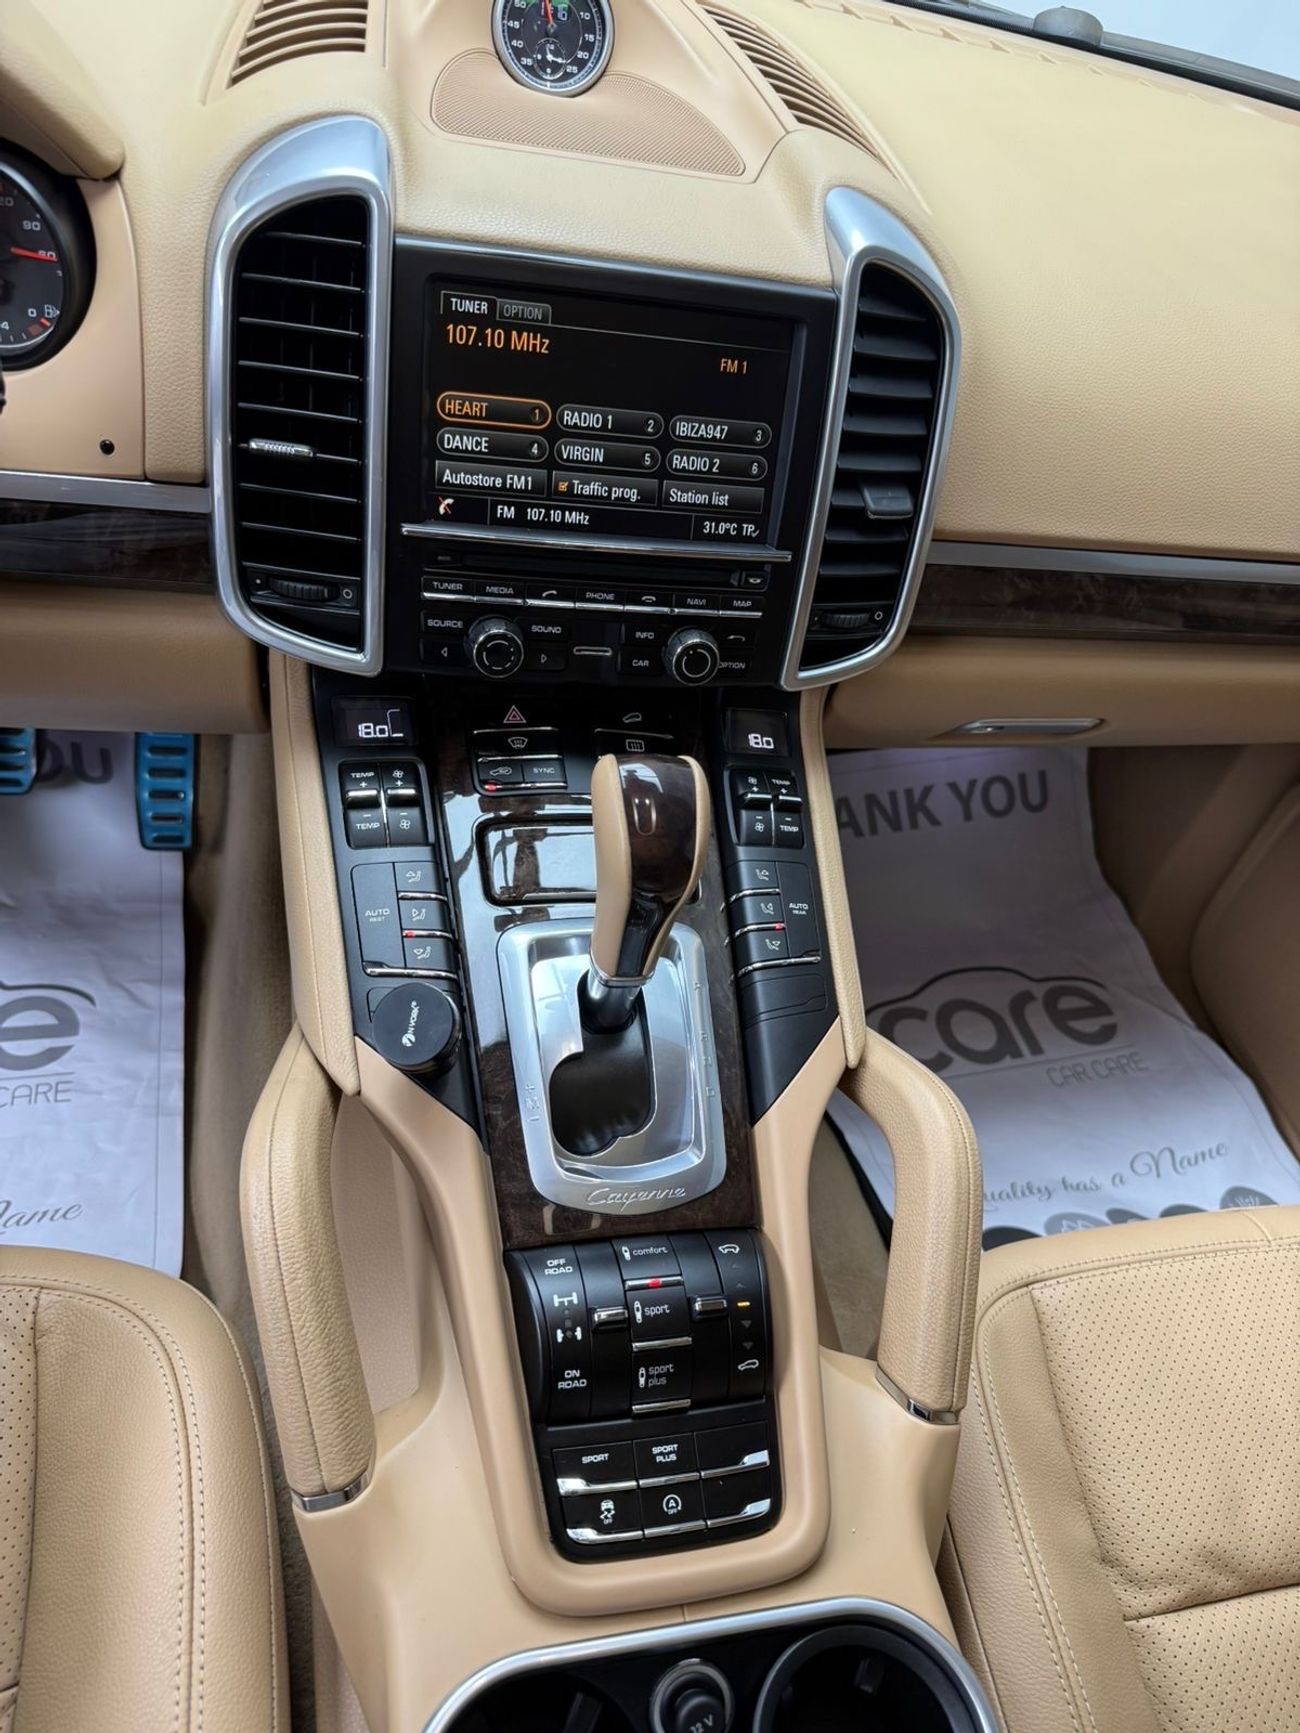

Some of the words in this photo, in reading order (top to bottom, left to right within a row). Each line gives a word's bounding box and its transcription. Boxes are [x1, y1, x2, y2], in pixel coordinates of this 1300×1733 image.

[580, 12, 590, 20] 10
[507, 21, 519, 29] 45
[584, 34, 594, 42] 15
[511, 40, 523, 48] 40
[577, 51, 589, 59] 20
[520, 58, 532, 66] 35
[567, 65, 578, 73] 25
[23, 220, 41, 231] 90
[450, 298, 488, 315] TUNER
[503, 303, 543, 320] OPTION
[446, 324, 505, 349] 107.10
[511, 329, 550, 354] MHz
[720, 358, 738, 374] FM
[741, 361, 748, 375] 1
[444, 399, 489, 417] HEART
[534, 409, 540, 421] 1
[563, 410, 603, 429] RADIO
[607, 415, 613, 430] 1
[647, 419, 654, 432] 2
[675, 421, 728, 441] IBIZA947
[755, 429, 763, 442] 3
[444, 434, 489, 452] DANCE
[531, 442, 539, 455] 4
[561, 445, 604, 463] VIRGIN
[644, 453, 651, 465] 5
[672, 455, 710, 472] RADIO
[712, 458, 720, 473] 2
[751, 461, 758, 474] 6
[442, 469, 502, 489] Autostore
[506, 473, 533, 490] FM1
[572, 480, 608, 498] Traffic
[611, 485, 641, 502] prog.
[669, 488, 708, 506] Station
[711, 491, 729, 506] list
[497, 506, 515, 519] FM
[526, 508, 562, 523] 107.10
[564, 510, 590, 525] MHz
[433, 582, 463, 590] TUNER
[486, 586, 514, 595] MEDIA
[586, 591, 615, 601] PHONE
[687, 597, 707, 606] NAVI
[733, 599, 752, 608] MAP
[427, 619, 464, 629] SOURCE
[531, 625, 562, 635] SOUND
[635, 631, 655, 640] INFO
[632, 659, 649, 668] CAR
[358, 723, 389, 738] 18.0
[748, 733, 774, 749] 18.0
[350, 771, 375, 779] TEMP
[771, 778, 791, 786] TEMP
[946, 769, 1049, 822] YOU
[356, 822, 380, 830] TEMP
[779, 824, 799, 832] TEMP
[789, 902, 808, 910] AUTO
[365, 908, 390, 917] AUTO
[877, 984, 1118, 1072] care
[1045, 1058, 1088, 1087] CAR
[1090, 1050, 1150, 1079] CARE
[984, 1178, 1053, 1202] uality
[1062, 1176, 1101, 1192] has
[1111, 1172, 1127, 1187] a
[1130, 1142, 1229, 1179] Name
[587, 1187, 687, 1212] Cayenne
[0, 1200, 83, 1235] ame
[632, 1246, 668, 1257] comfort
[547, 1259, 566, 1267] OFF
[544, 1265, 573, 1275] ROAD
[644, 1304, 670, 1316] sport
[564, 1370, 580, 1378] ON
[648, 1363, 675, 1375] sport
[558, 1379, 587, 1389] ROAD
[648, 1375, 667, 1387] plus
[652, 1444, 678, 1454] SPORT
[582, 1453, 609, 1464] SPORT
[656, 1454, 677, 1462] PLUS
